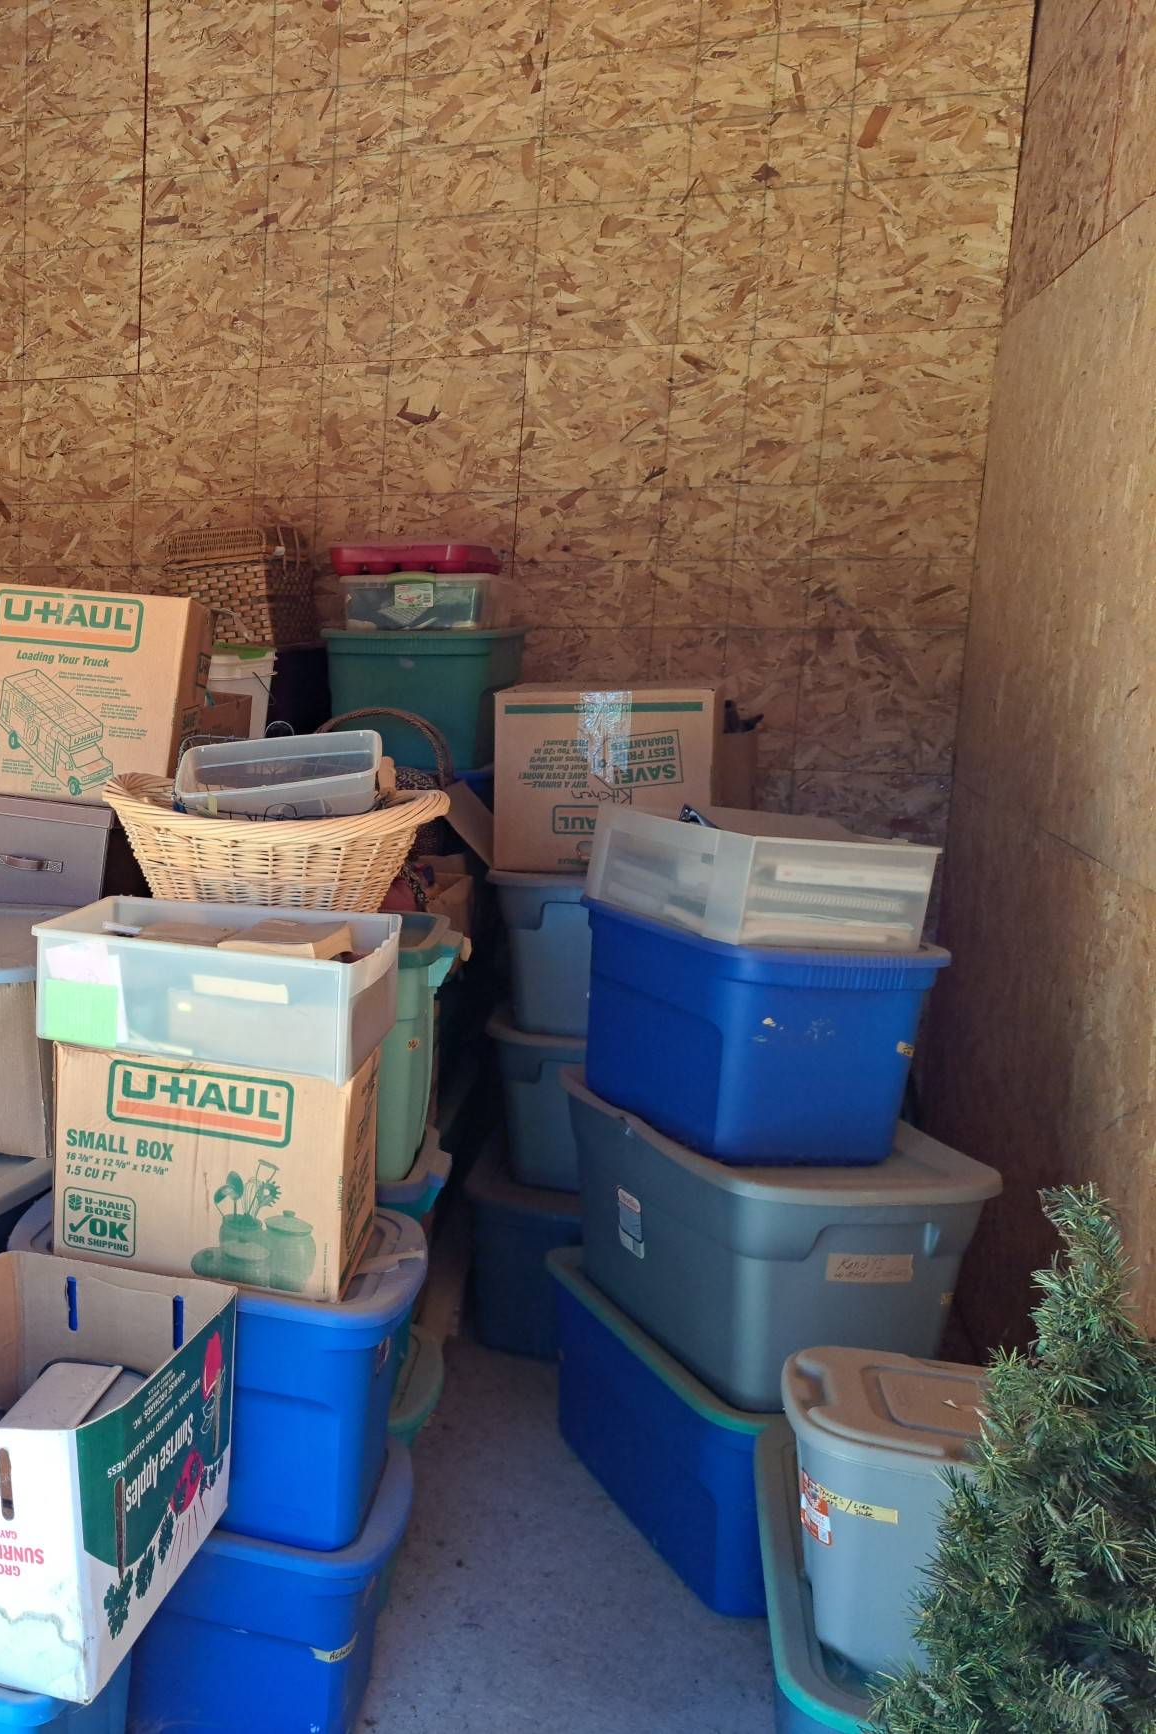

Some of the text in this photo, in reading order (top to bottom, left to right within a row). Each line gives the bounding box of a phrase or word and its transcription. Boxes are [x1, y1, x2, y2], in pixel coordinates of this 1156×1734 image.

[4, 598, 132, 631] U-HAUL
[16, 649, 111, 668] Loading Your Truck
[73, 730, 99, 745] U-HAUL
[647, 748, 676, 759] BEST
[614, 764, 676, 784] SAVE!
[571, 786, 633, 805] Kitchen
[121, 1069, 280, 1121] U-HAUL
[65, 1128, 174, 1162] SMALL BOX
[65, 1163, 117, 1182] 1.5 CU FT
[103, 1158, 114, 1167] 12
[140, 1164, 152, 1173] 12
[84, 1197, 132, 1213] U-HAUL
[84, 1205, 132, 1221] BOXES
[89, 1217, 129, 1243] OK
[68, 1233, 129, 1252] FOR SHIPPING
[145, 1427, 156, 1444] FOR
[125, 1412, 194, 1513] Sunrise Apples
